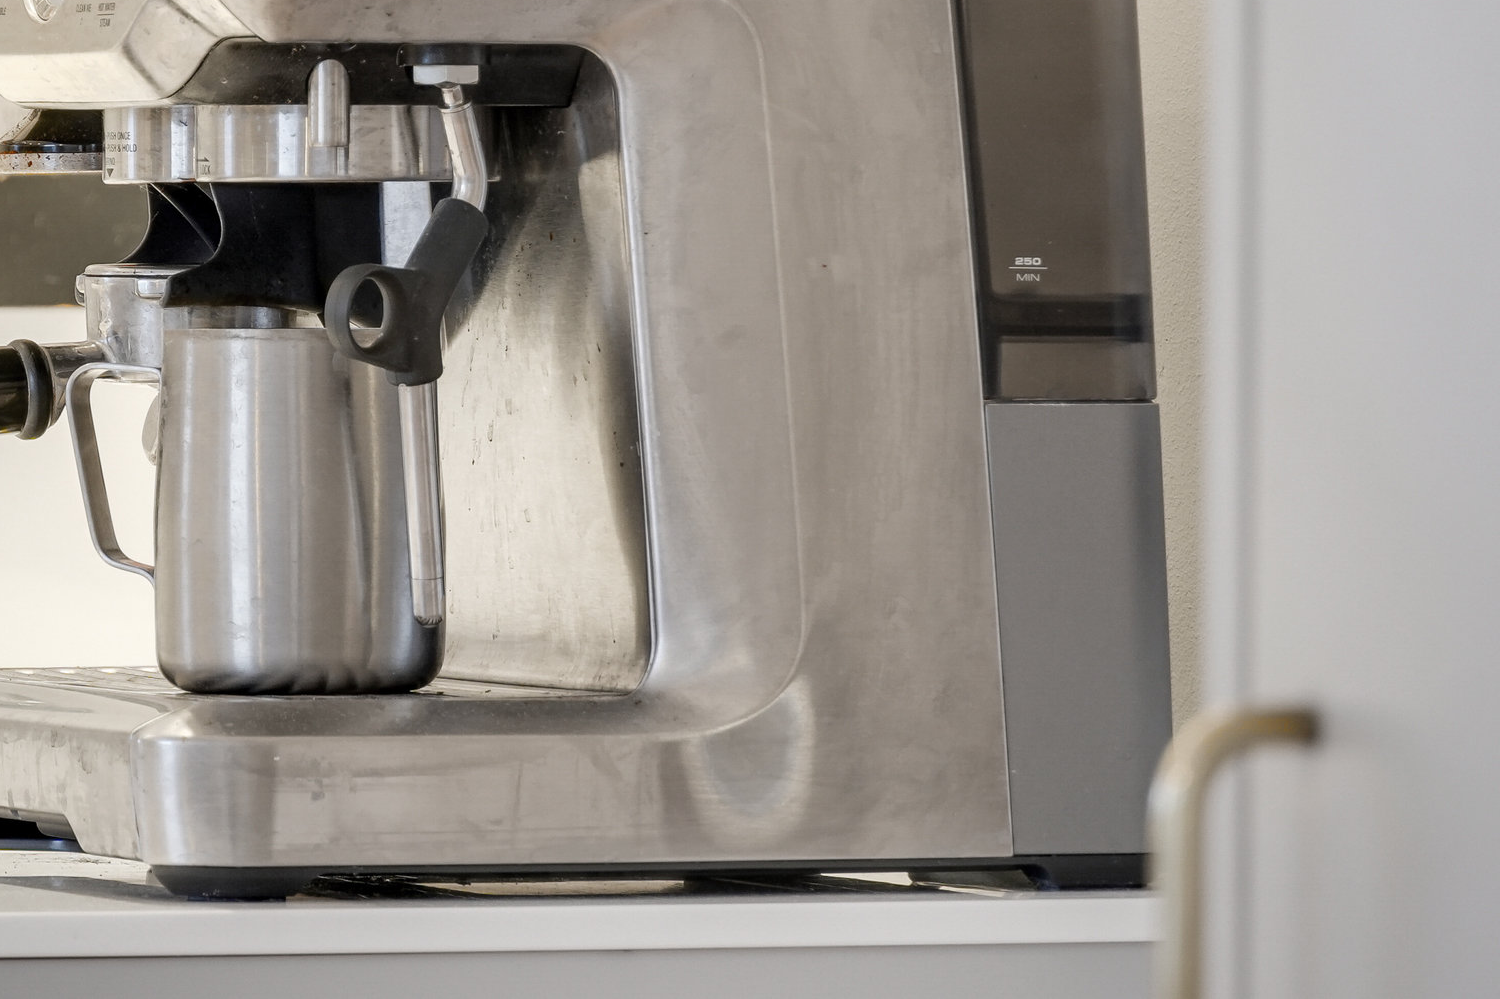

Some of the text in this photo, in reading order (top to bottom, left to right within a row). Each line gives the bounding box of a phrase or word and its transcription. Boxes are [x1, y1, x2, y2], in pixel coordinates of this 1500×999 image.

[117, 131, 131, 141] ONCE
[121, 143, 137, 153] HOLD
[1014, 256, 1042, 266] 250
[1015, 272, 1041, 282] MIN
